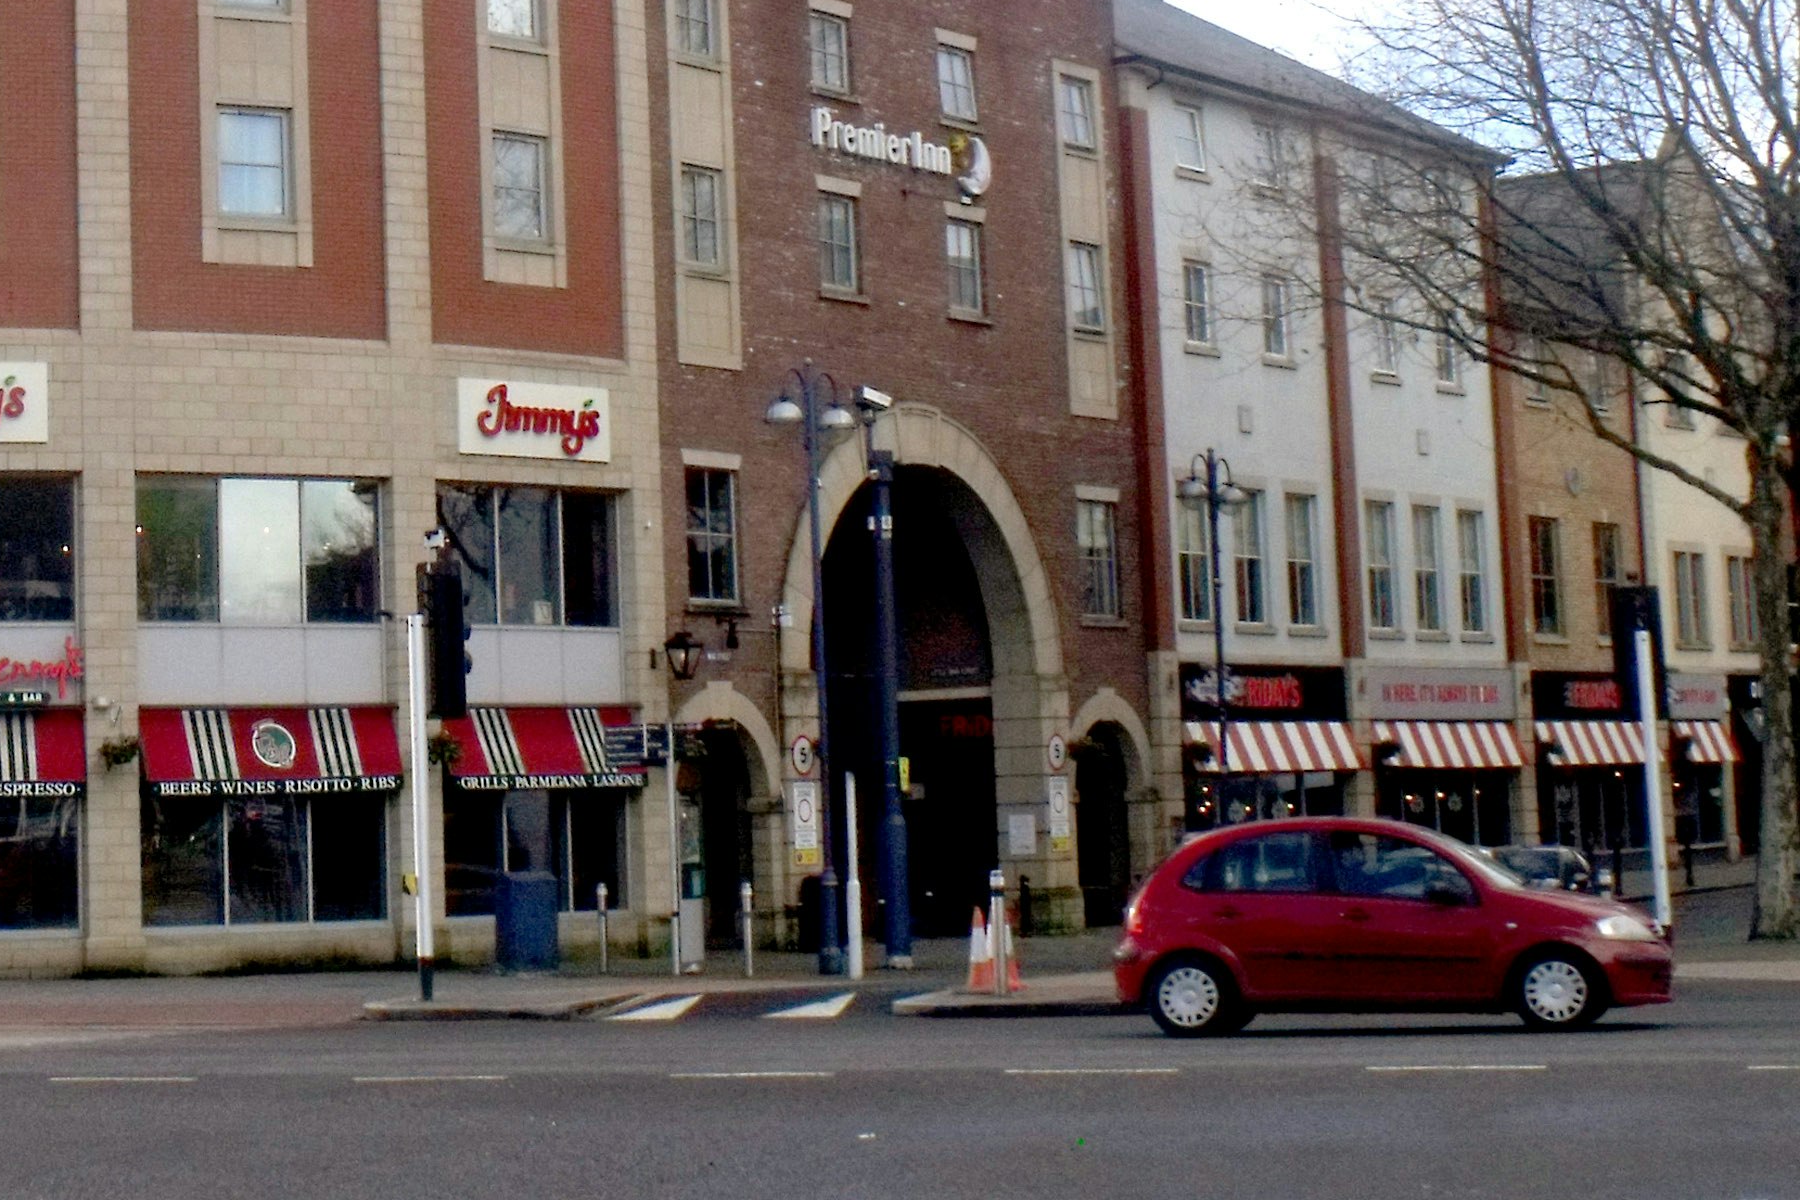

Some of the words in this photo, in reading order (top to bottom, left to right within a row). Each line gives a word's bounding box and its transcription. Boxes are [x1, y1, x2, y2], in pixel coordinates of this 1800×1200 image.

[811, 106, 911, 165] Premier
[910, 131, 952, 174] Inn
[476, 383, 600, 456] Jimmy's
[7, 693, 16, 703] &
[22, 693, 43, 702] BAR
[160, 781, 212, 796] BEERS
[220, 781, 276, 795] WINES
[285, 777, 352, 793] RISOTTO
[361, 775, 397, 791] RIBS
[460, 775, 510, 789] GRILLS
[592, 772, 644, 787] LASAGNE
